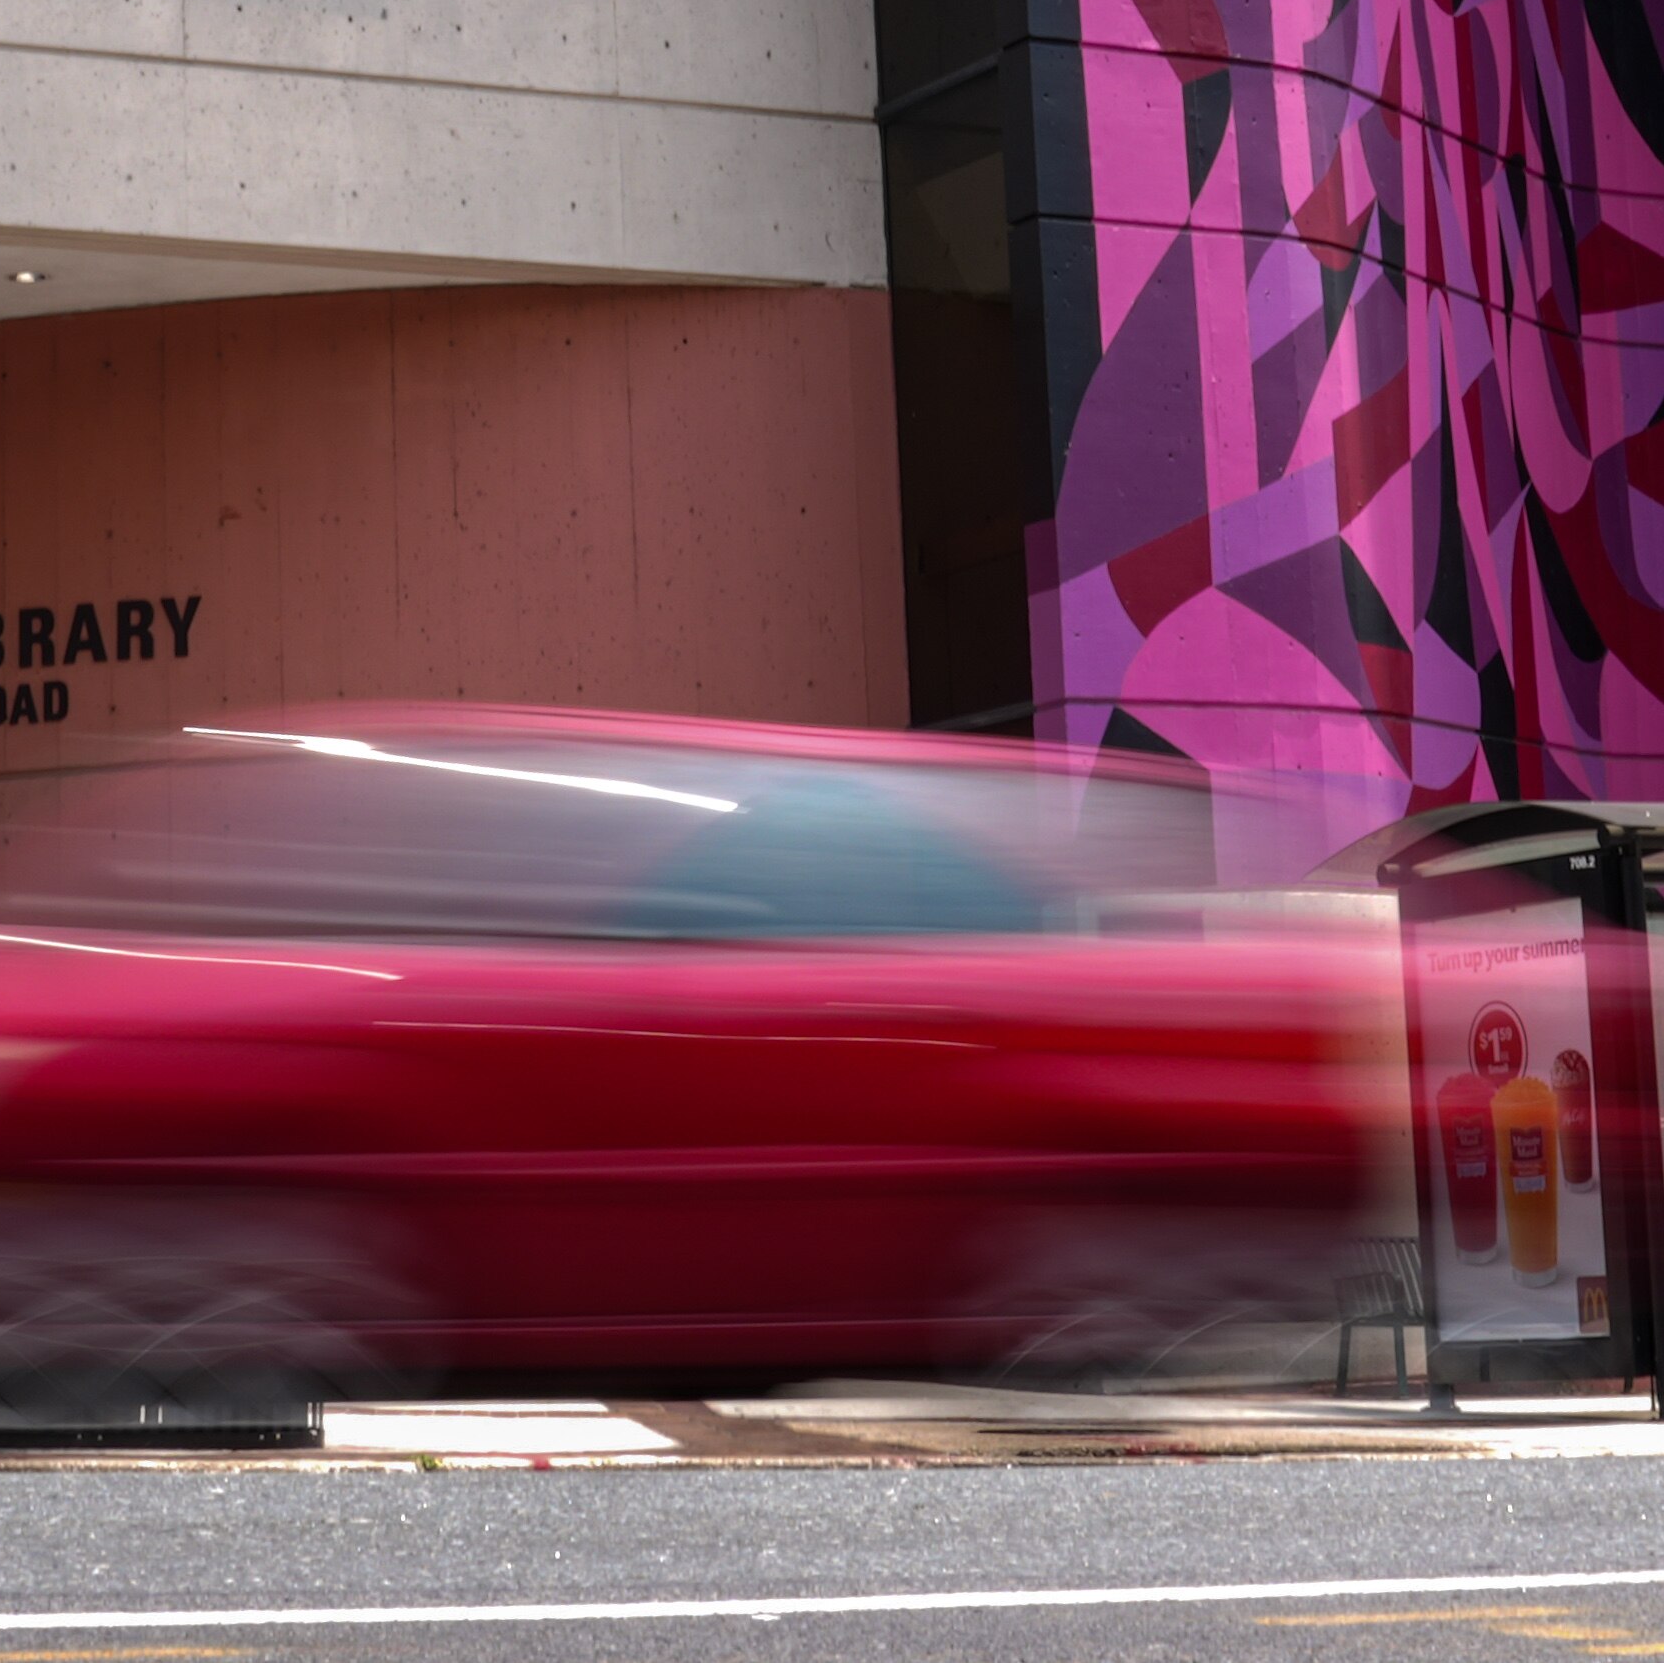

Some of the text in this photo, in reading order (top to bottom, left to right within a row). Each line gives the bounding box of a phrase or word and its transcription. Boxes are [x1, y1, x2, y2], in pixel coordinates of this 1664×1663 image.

[1427, 952, 1461, 973] Turn
[1463, 950, 1483, 973] up
[1485, 945, 1520, 973] your
